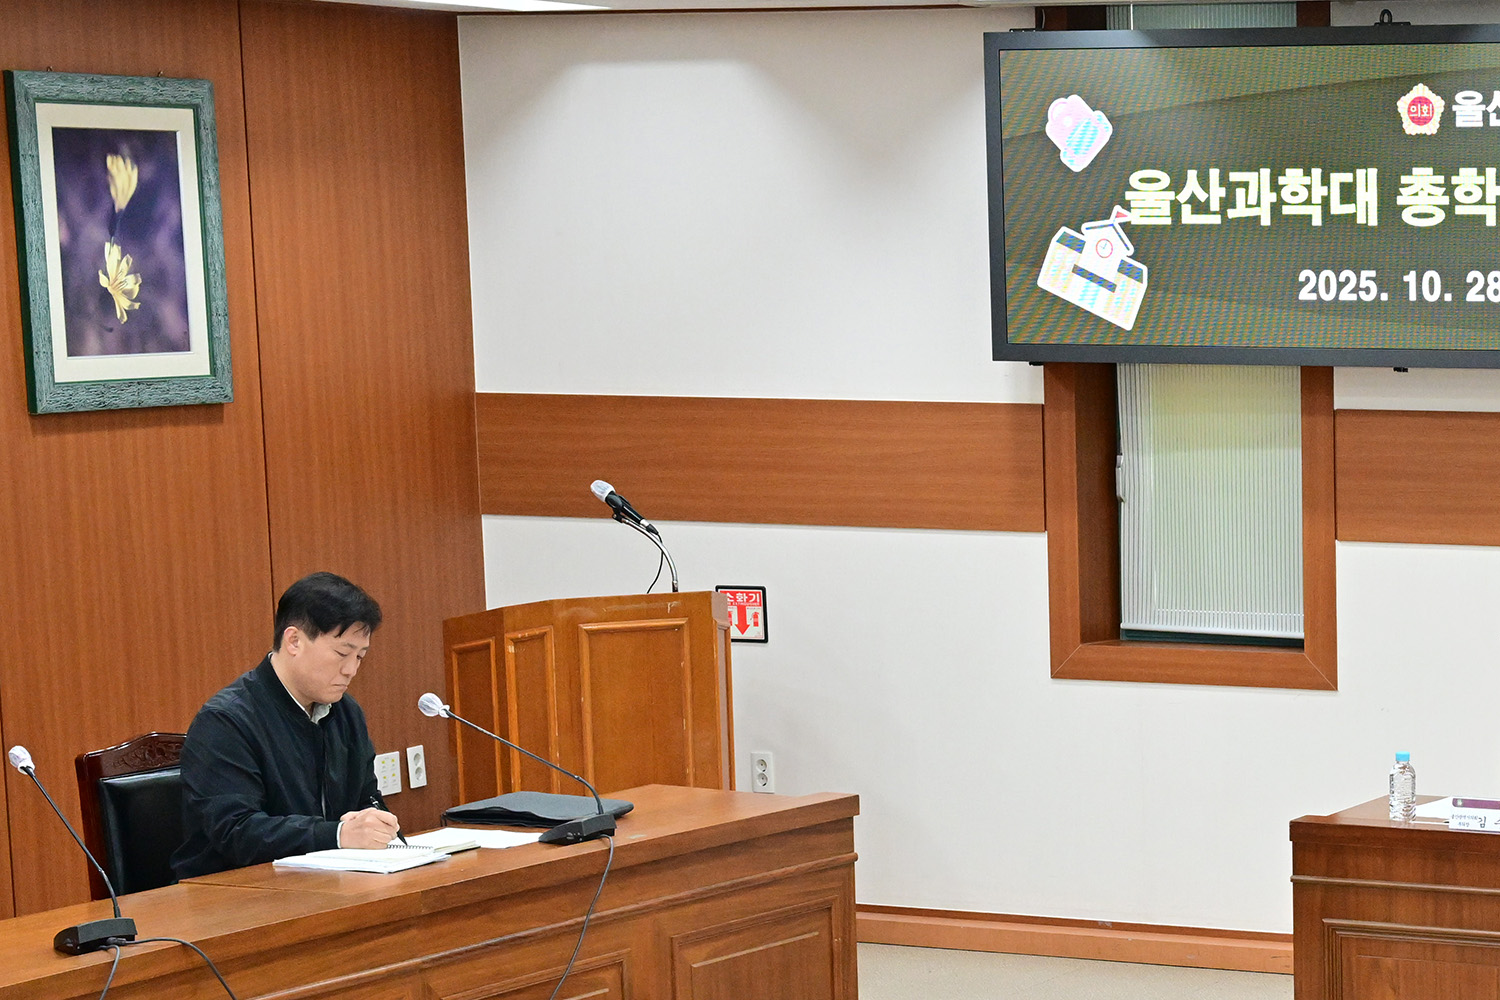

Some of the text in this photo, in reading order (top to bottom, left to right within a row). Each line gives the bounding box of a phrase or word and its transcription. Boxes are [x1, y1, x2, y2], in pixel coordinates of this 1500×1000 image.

[1410, 103, 1433, 118] 의회
[1125, 167, 1378, 227] 울산과학대
[1299, 270, 1389, 302] 2025.
[1403, 271, 1452, 302] 10.
